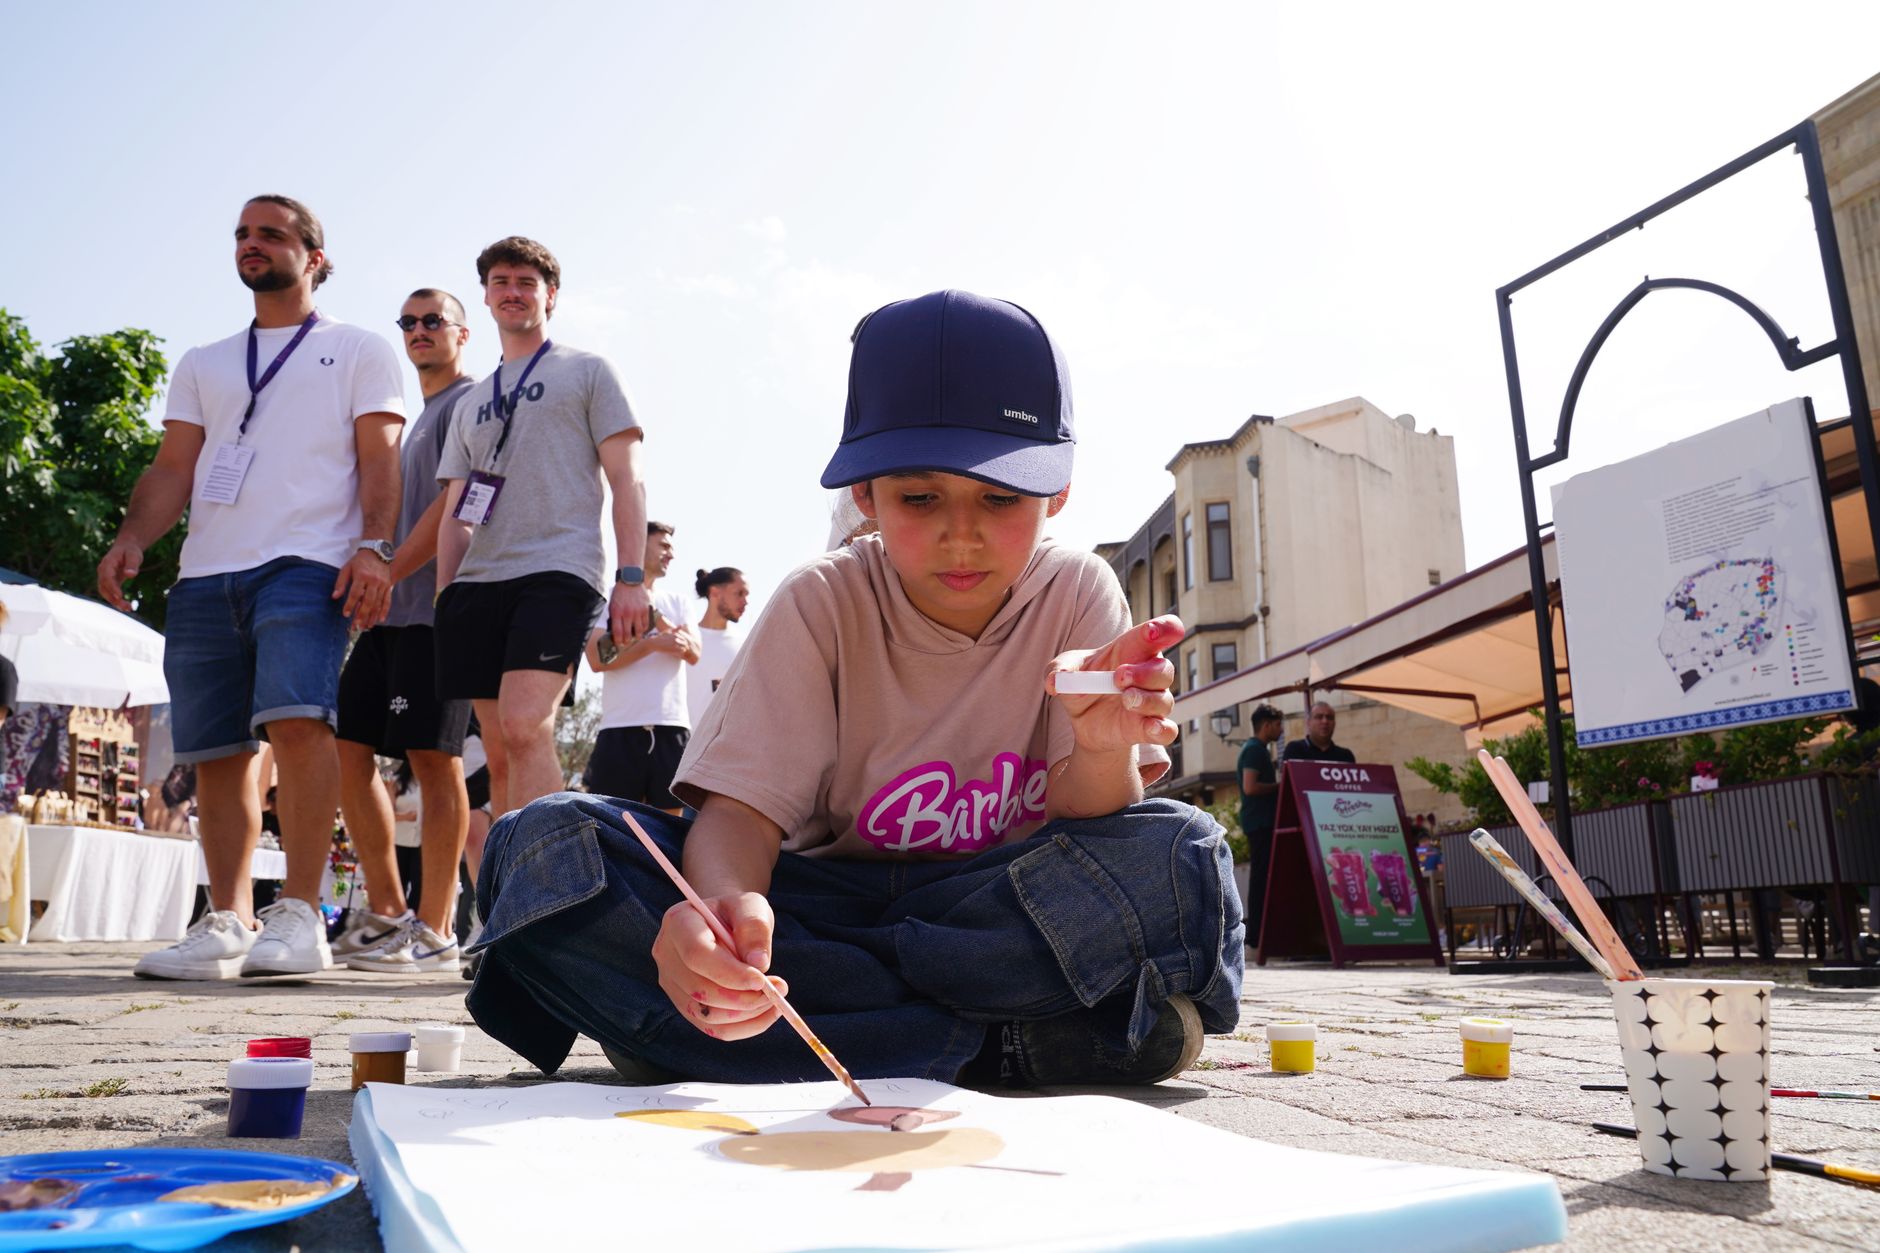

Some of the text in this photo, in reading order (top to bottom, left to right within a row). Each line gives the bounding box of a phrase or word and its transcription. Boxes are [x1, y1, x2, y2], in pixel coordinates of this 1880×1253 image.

[1004, 409, 1038, 423] umbro
[1320, 767, 1371, 783] COSTA
[1334, 783, 1362, 791] COFFEE
